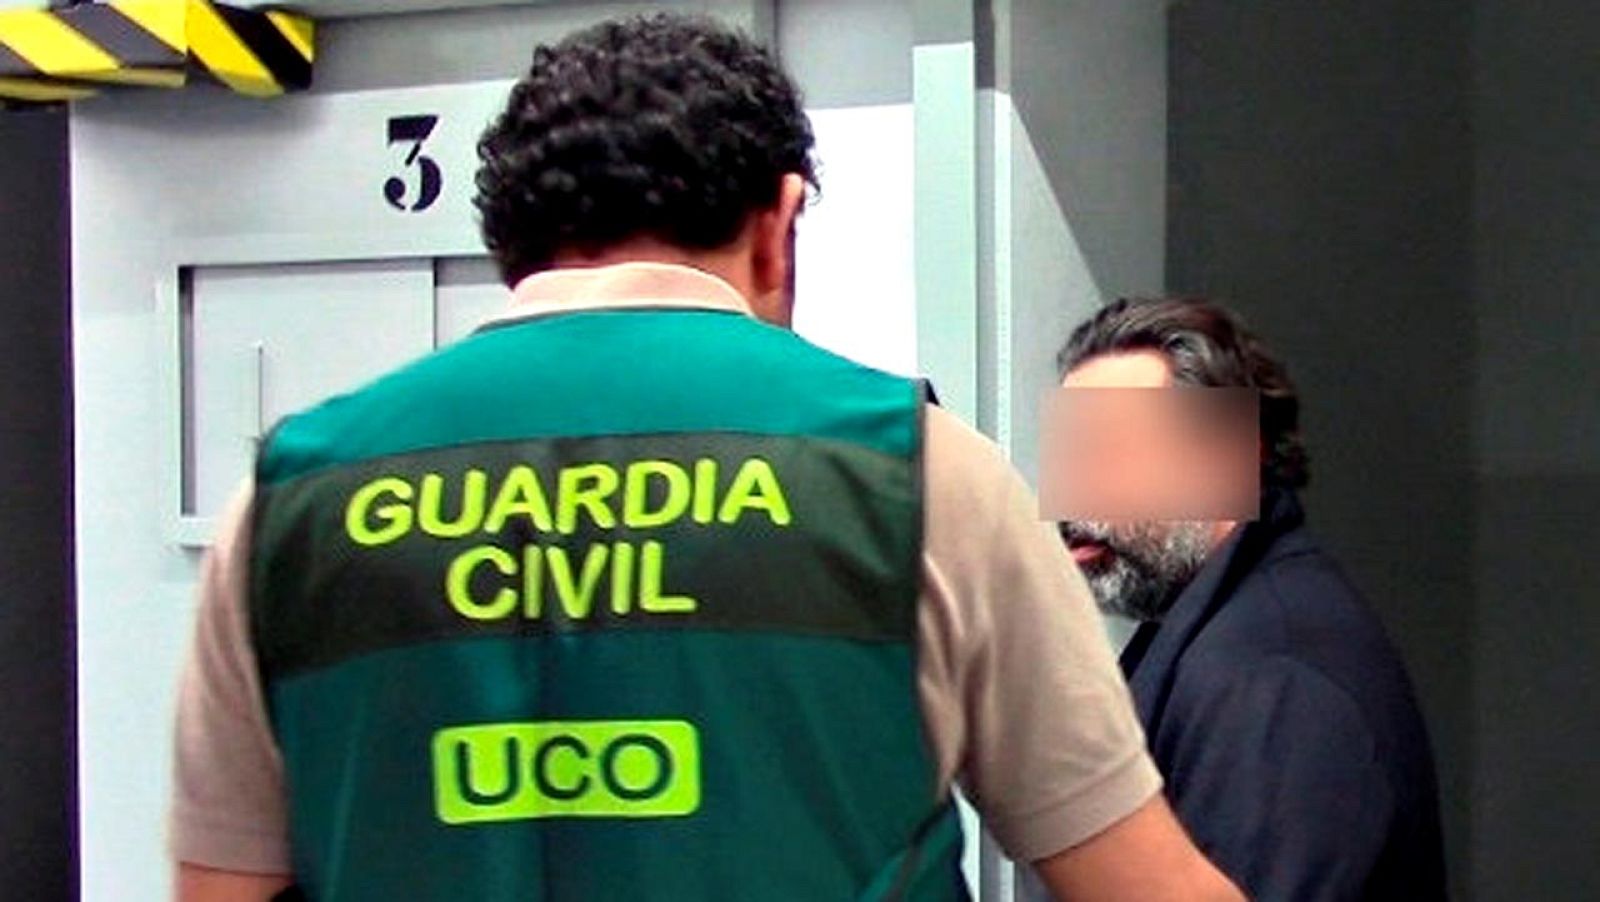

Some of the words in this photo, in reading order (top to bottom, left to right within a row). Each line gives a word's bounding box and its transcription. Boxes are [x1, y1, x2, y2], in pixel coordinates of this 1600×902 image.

[383, 115, 442, 212] 3
[345, 459, 792, 546] GUARDIA
[446, 540, 697, 620] CIVIL
[455, 733, 673, 806] UCO
